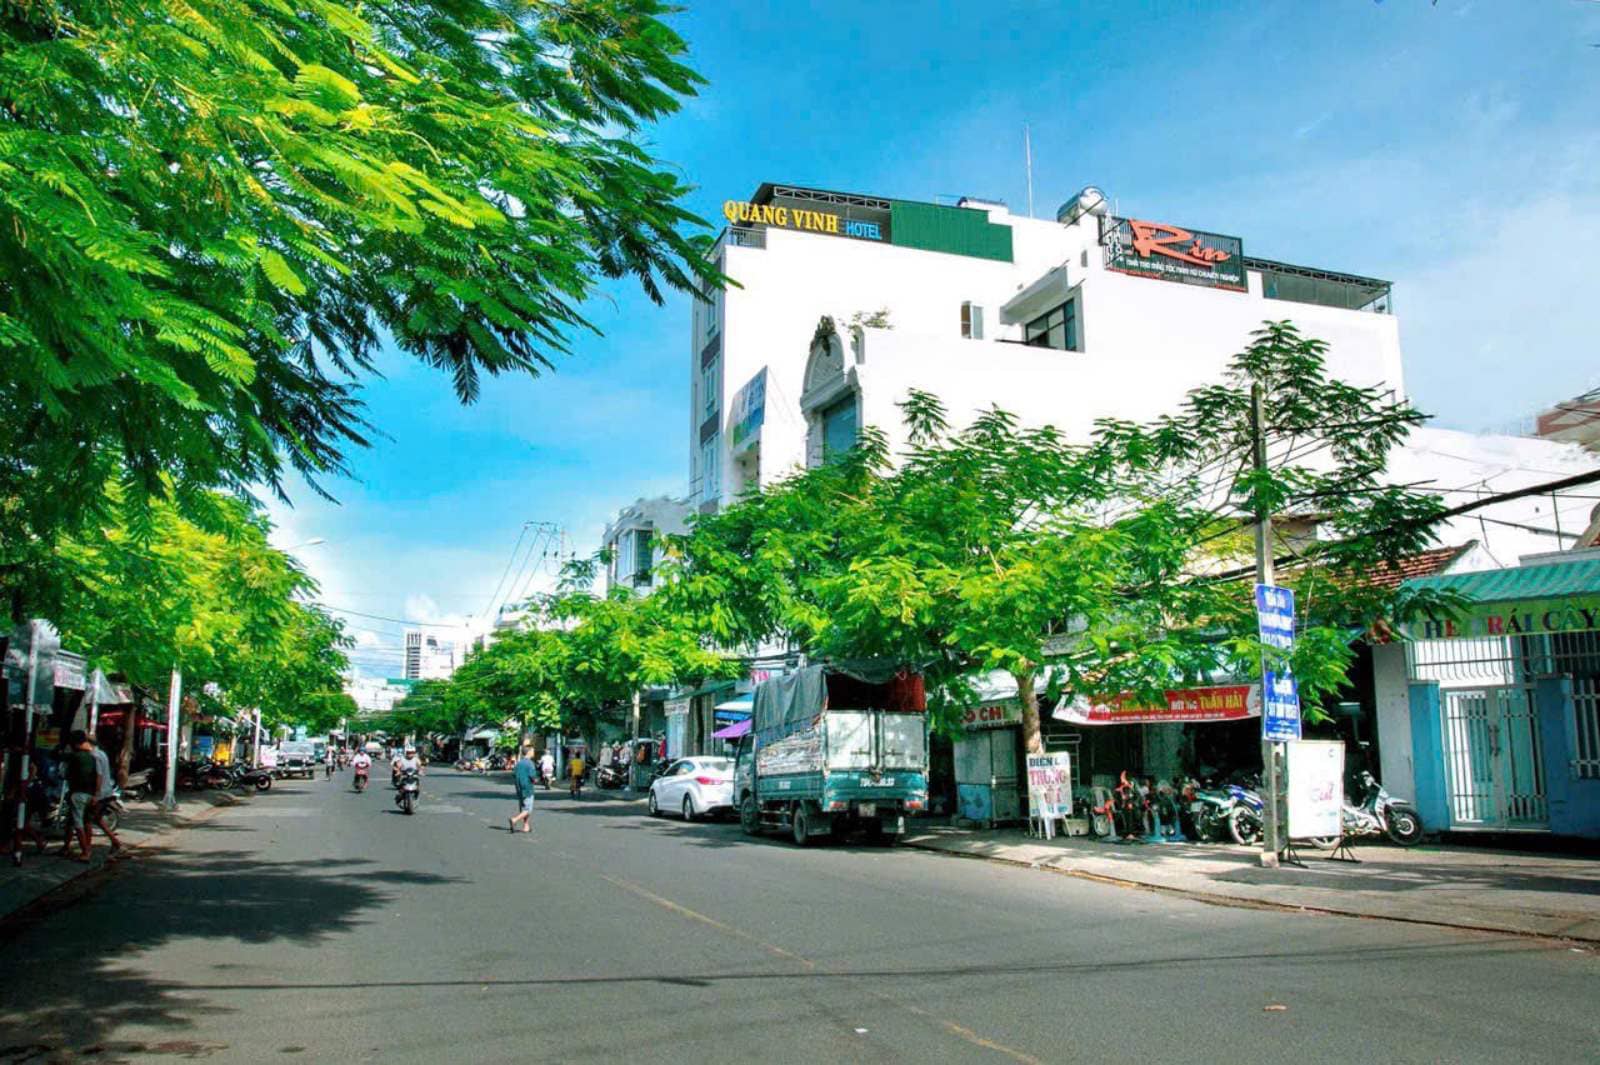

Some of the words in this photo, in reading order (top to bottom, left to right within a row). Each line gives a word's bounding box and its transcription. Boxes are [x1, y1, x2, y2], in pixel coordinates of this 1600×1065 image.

[723, 200, 787, 226] QUANG
[791, 208, 838, 233] VINH
[845, 219, 882, 240] HOTEL
[1542, 602, 1599, 632] CÂY
